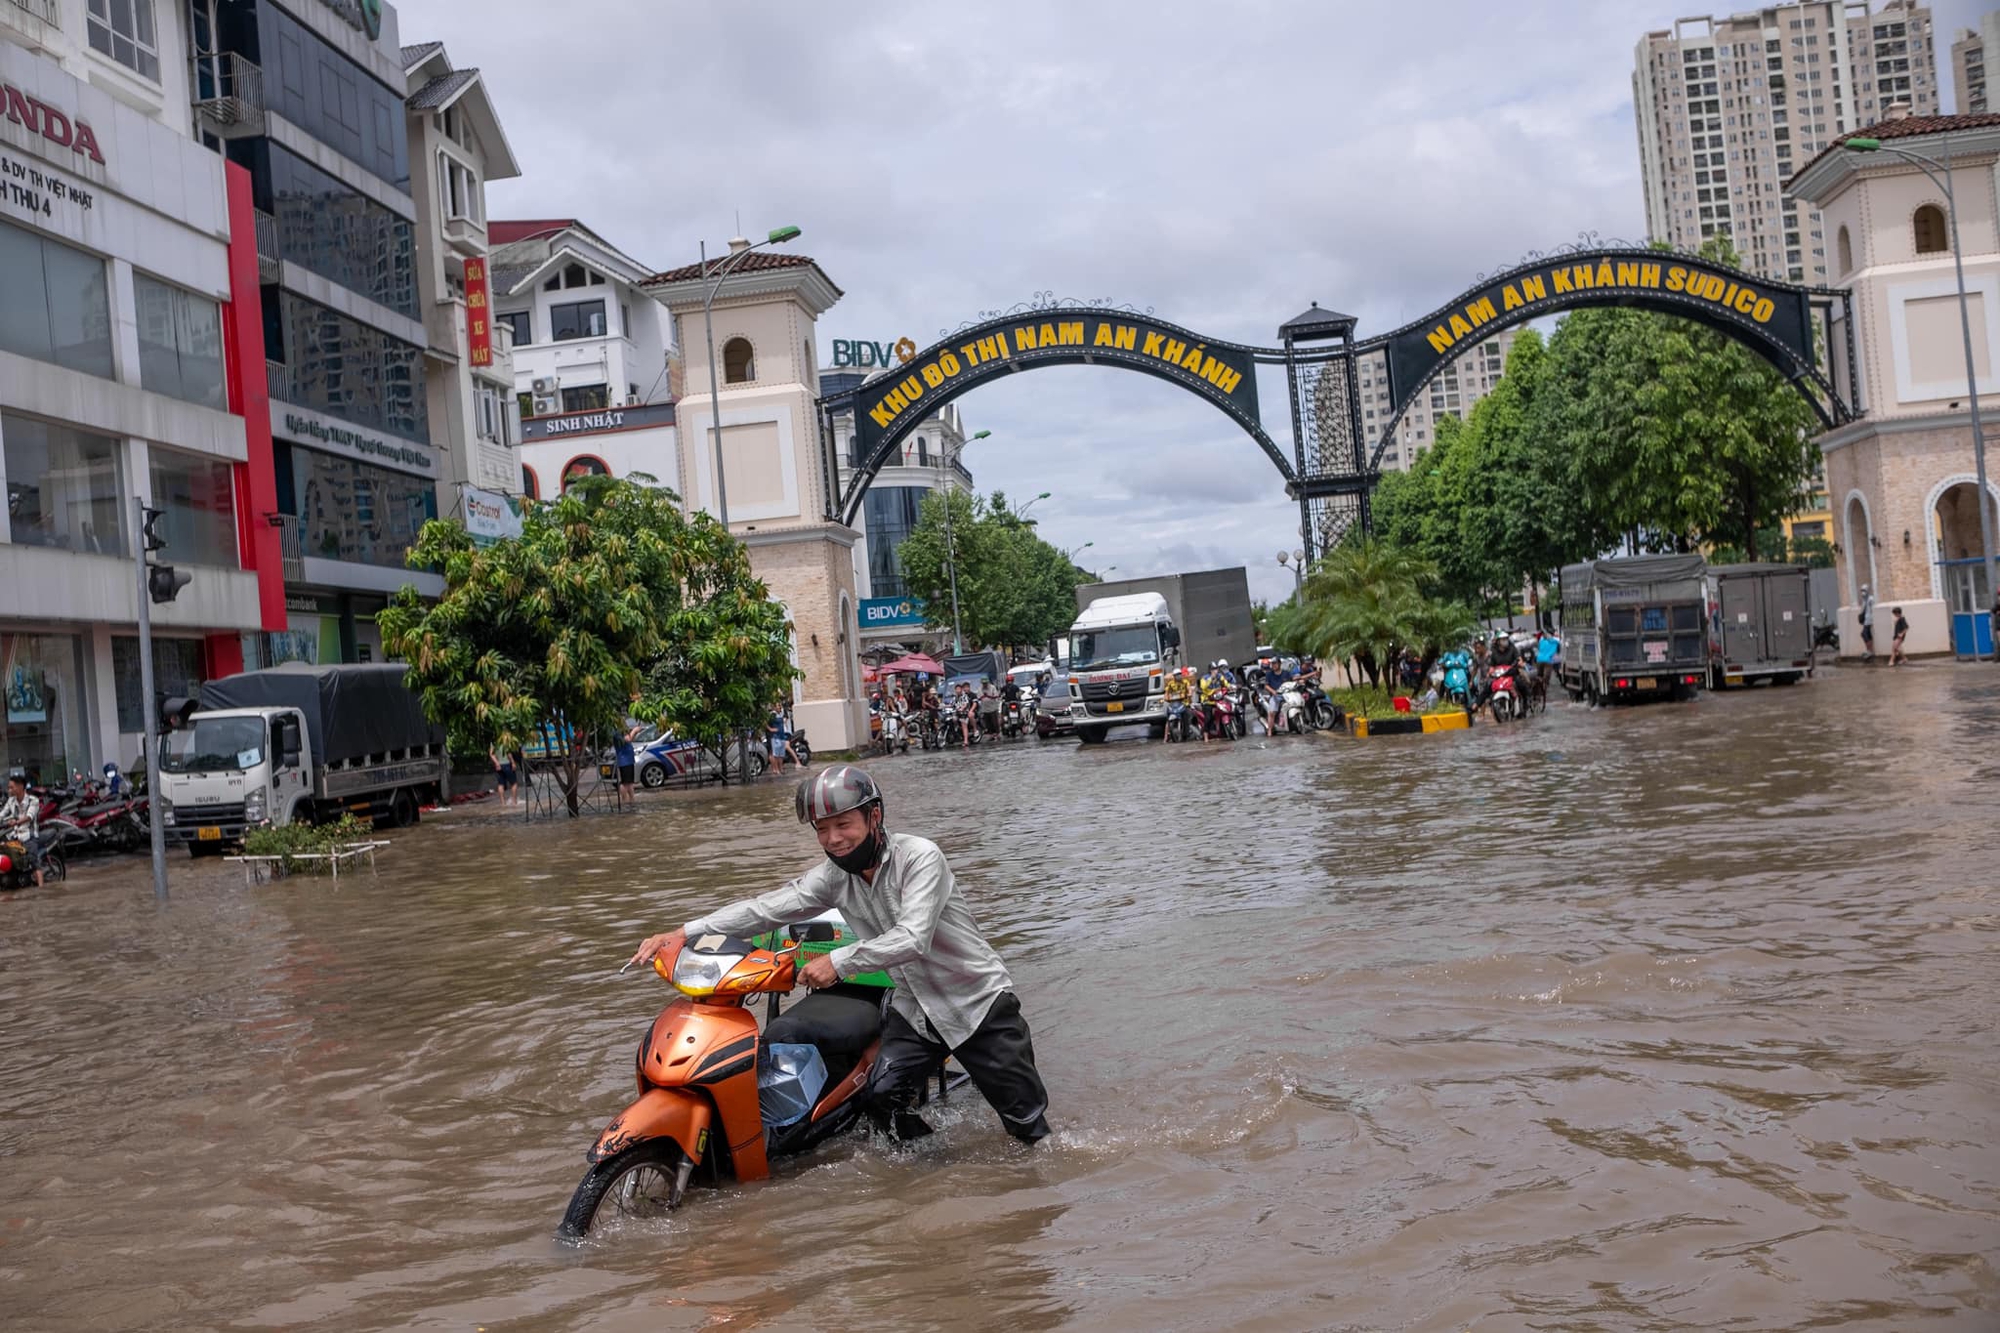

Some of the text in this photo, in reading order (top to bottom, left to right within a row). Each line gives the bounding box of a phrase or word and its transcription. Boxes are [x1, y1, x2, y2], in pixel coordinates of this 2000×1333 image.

[0, 83, 106, 166] NDA
[12, 162, 26, 180] DV
[29, 169, 43, 188] TH
[45, 175, 66, 199] VIỆT
[69, 186, 93, 210] NHẬT
[42, 198, 51, 217] 4
[1426, 256, 1775, 355] NAM AN KHÁNH SUDICO
[473, 321, 484, 335] XE
[472, 344, 489, 363] MÁY
[832, 339, 895, 369] BIDV
[869, 321, 1242, 429] KHU ĐÔ THỊ NAM AN KHÁNH
[546, 411, 624, 434] SINH NHẬT
[285, 595, 319, 612] combank
[866, 604, 900, 620] BIDV
